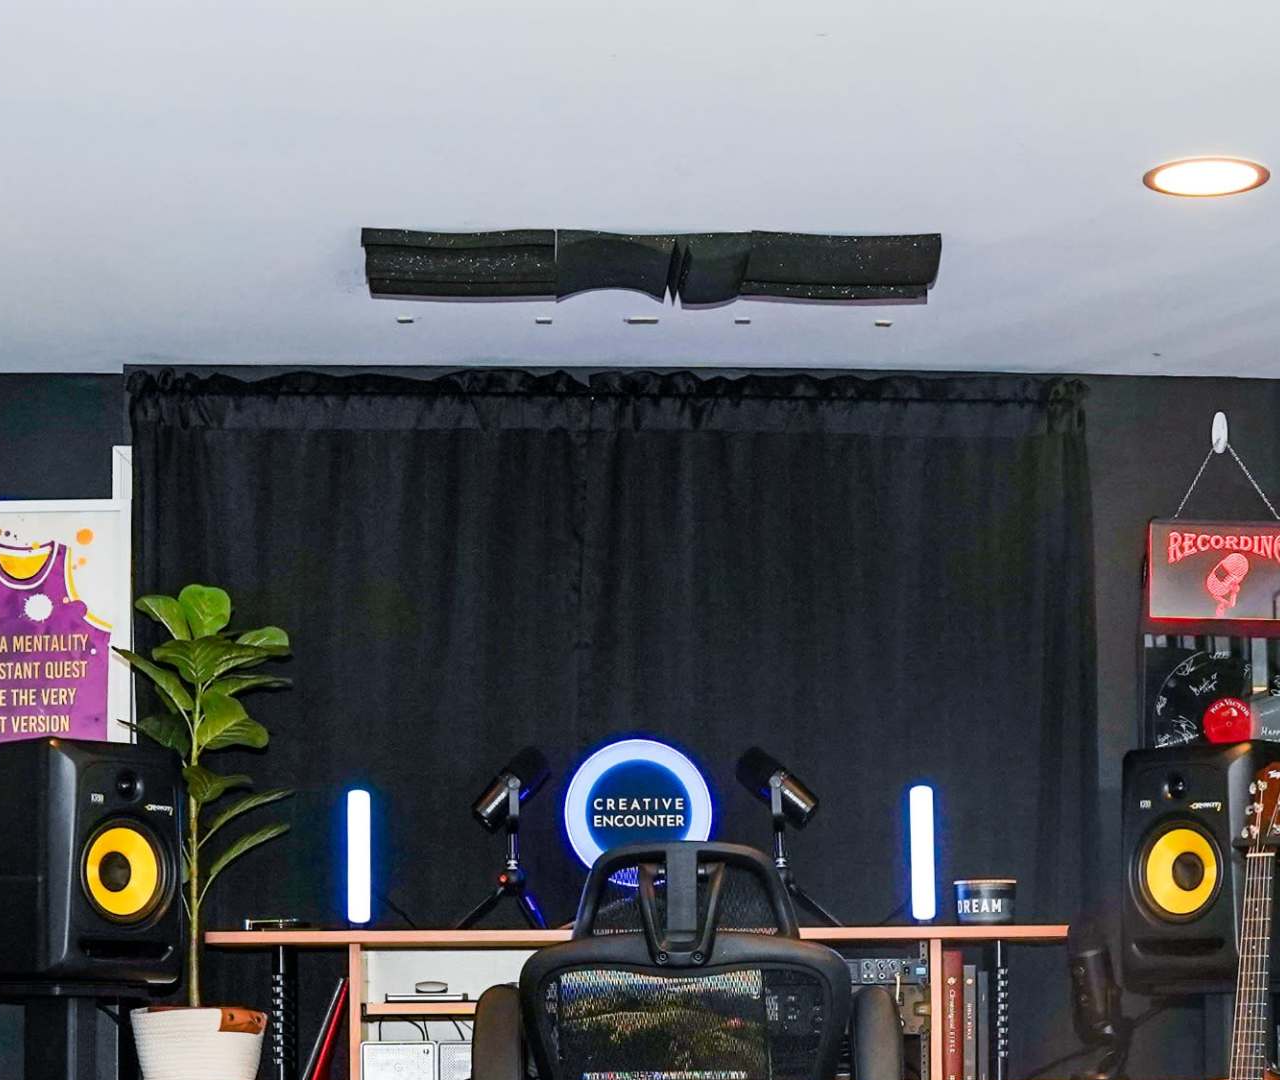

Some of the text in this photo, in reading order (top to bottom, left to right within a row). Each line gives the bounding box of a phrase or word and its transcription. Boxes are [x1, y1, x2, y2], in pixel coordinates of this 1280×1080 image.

[12, 633, 89, 653] MENTALITY
[45, 660, 88, 679] QUEST
[11, 688, 37, 706] THE
[41, 687, 77, 705] VERY
[11, 714, 70, 733] VERSION
[593, 797, 685, 811] CREATIVE
[593, 814, 685, 828] ENCOUNTER
[957, 898, 1002, 914] DREAM
